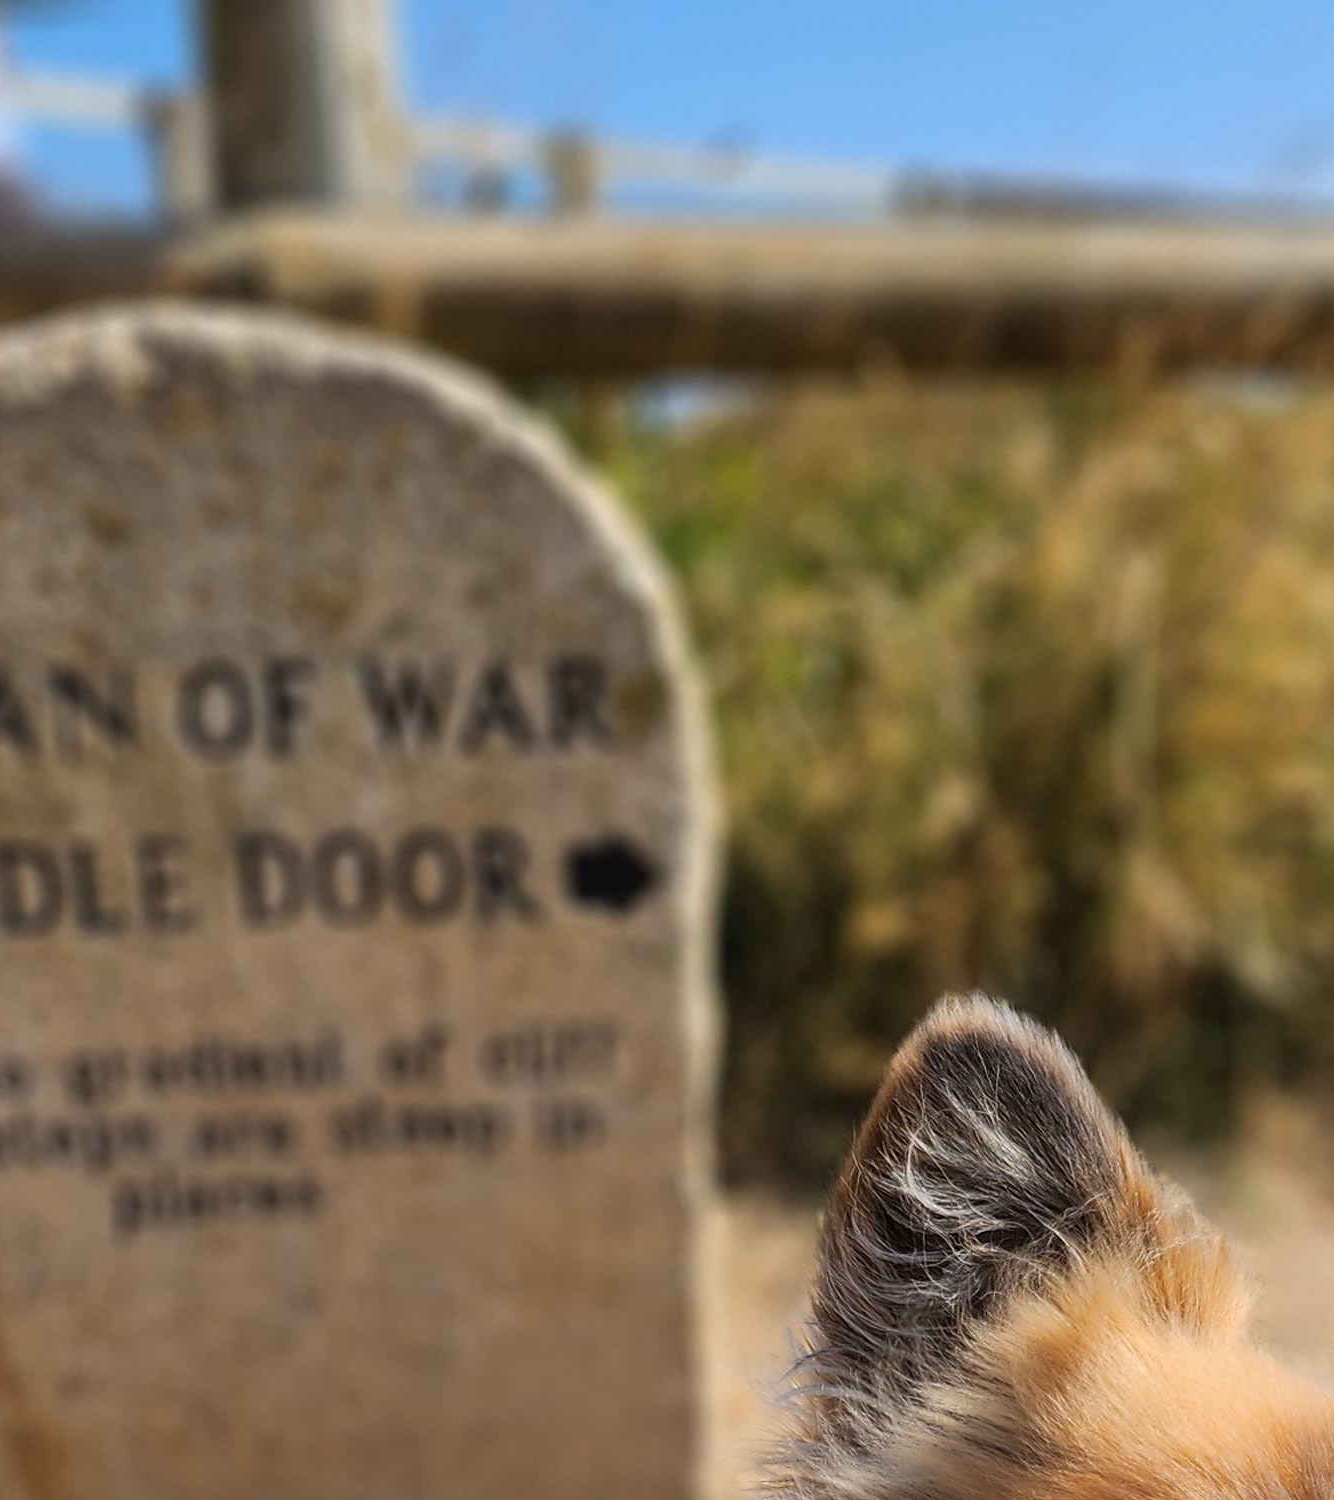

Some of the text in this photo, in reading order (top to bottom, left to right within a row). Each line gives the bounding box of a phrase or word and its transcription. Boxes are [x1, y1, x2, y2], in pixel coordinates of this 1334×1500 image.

[173, 654, 320, 764] OF
[357, 650, 623, 754] WAR
[235, 826, 547, 932] DOOR
[377, 1024, 453, 1090] of
[189, 1108, 297, 1156] are
